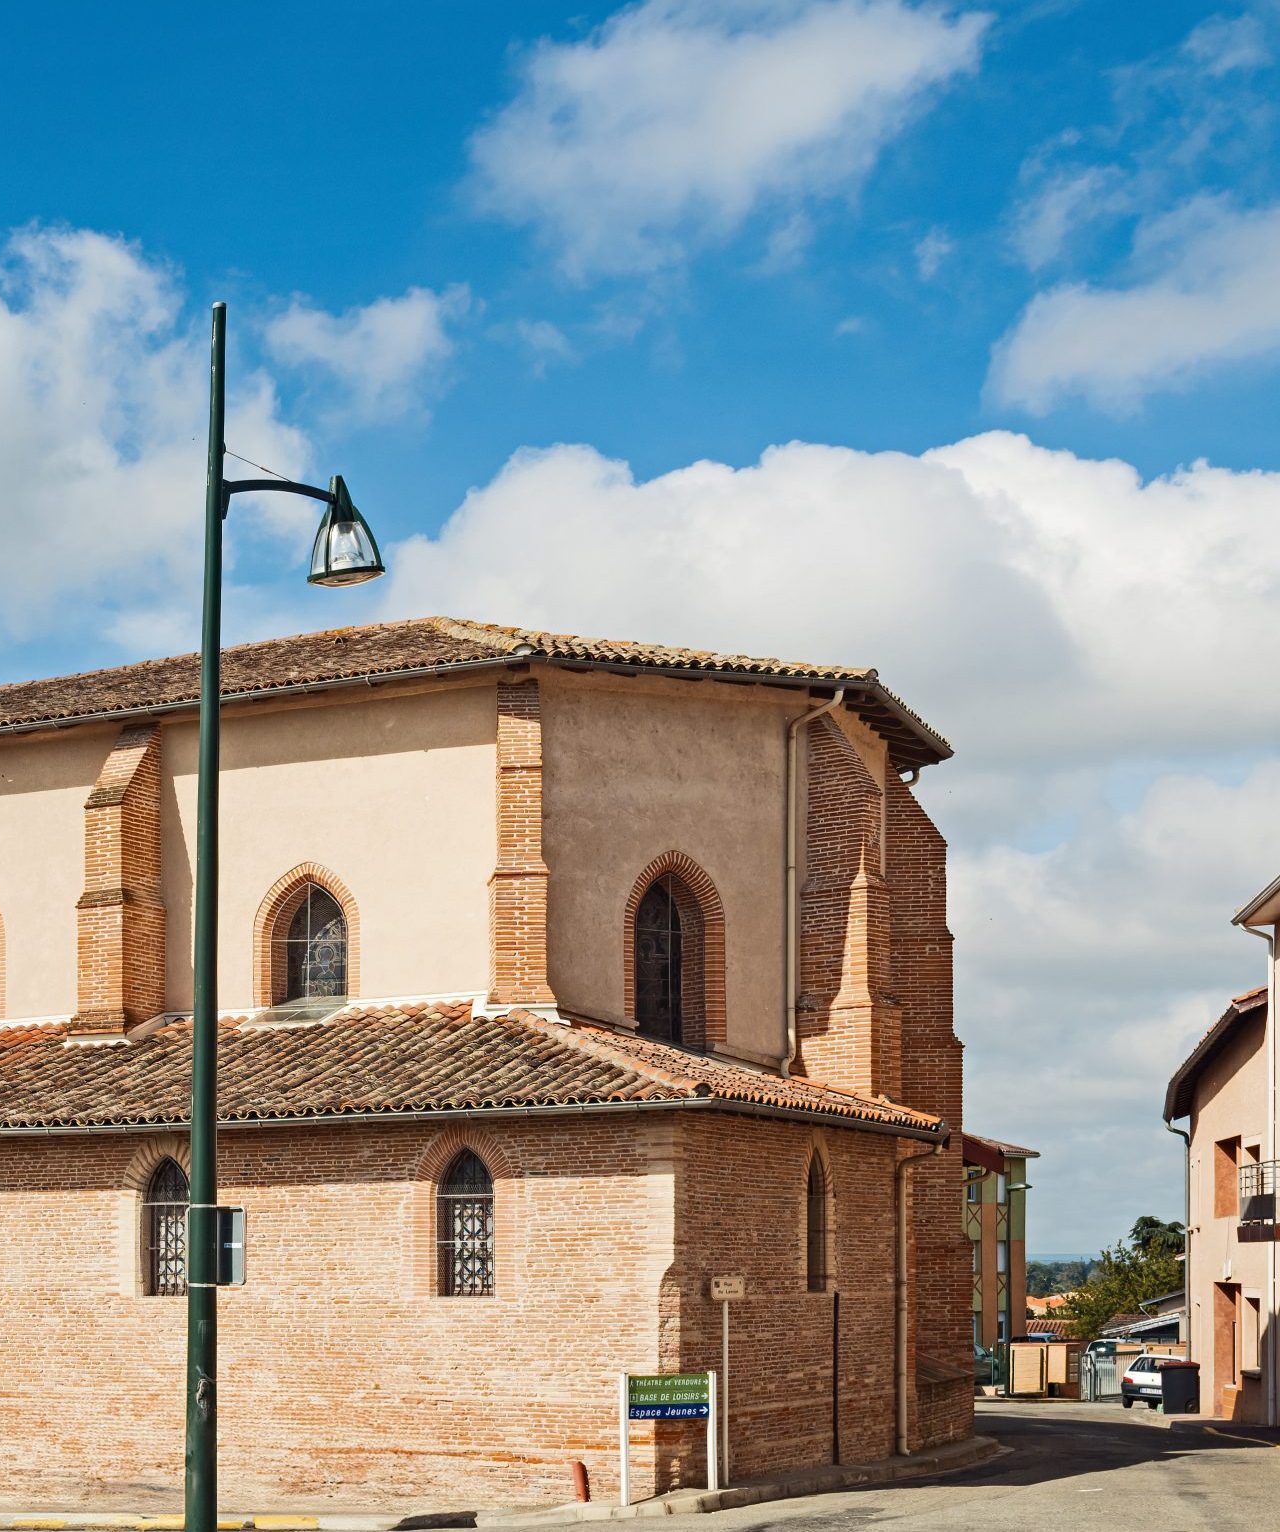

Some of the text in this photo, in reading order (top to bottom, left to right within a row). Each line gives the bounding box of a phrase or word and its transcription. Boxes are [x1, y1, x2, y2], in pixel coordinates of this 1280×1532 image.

[674, 1378, 701, 1386] VERDURE
[639, 1392, 700, 1402] BASE DE LOISIRS
[630, 1407, 697, 1419] Espace Jeunes
